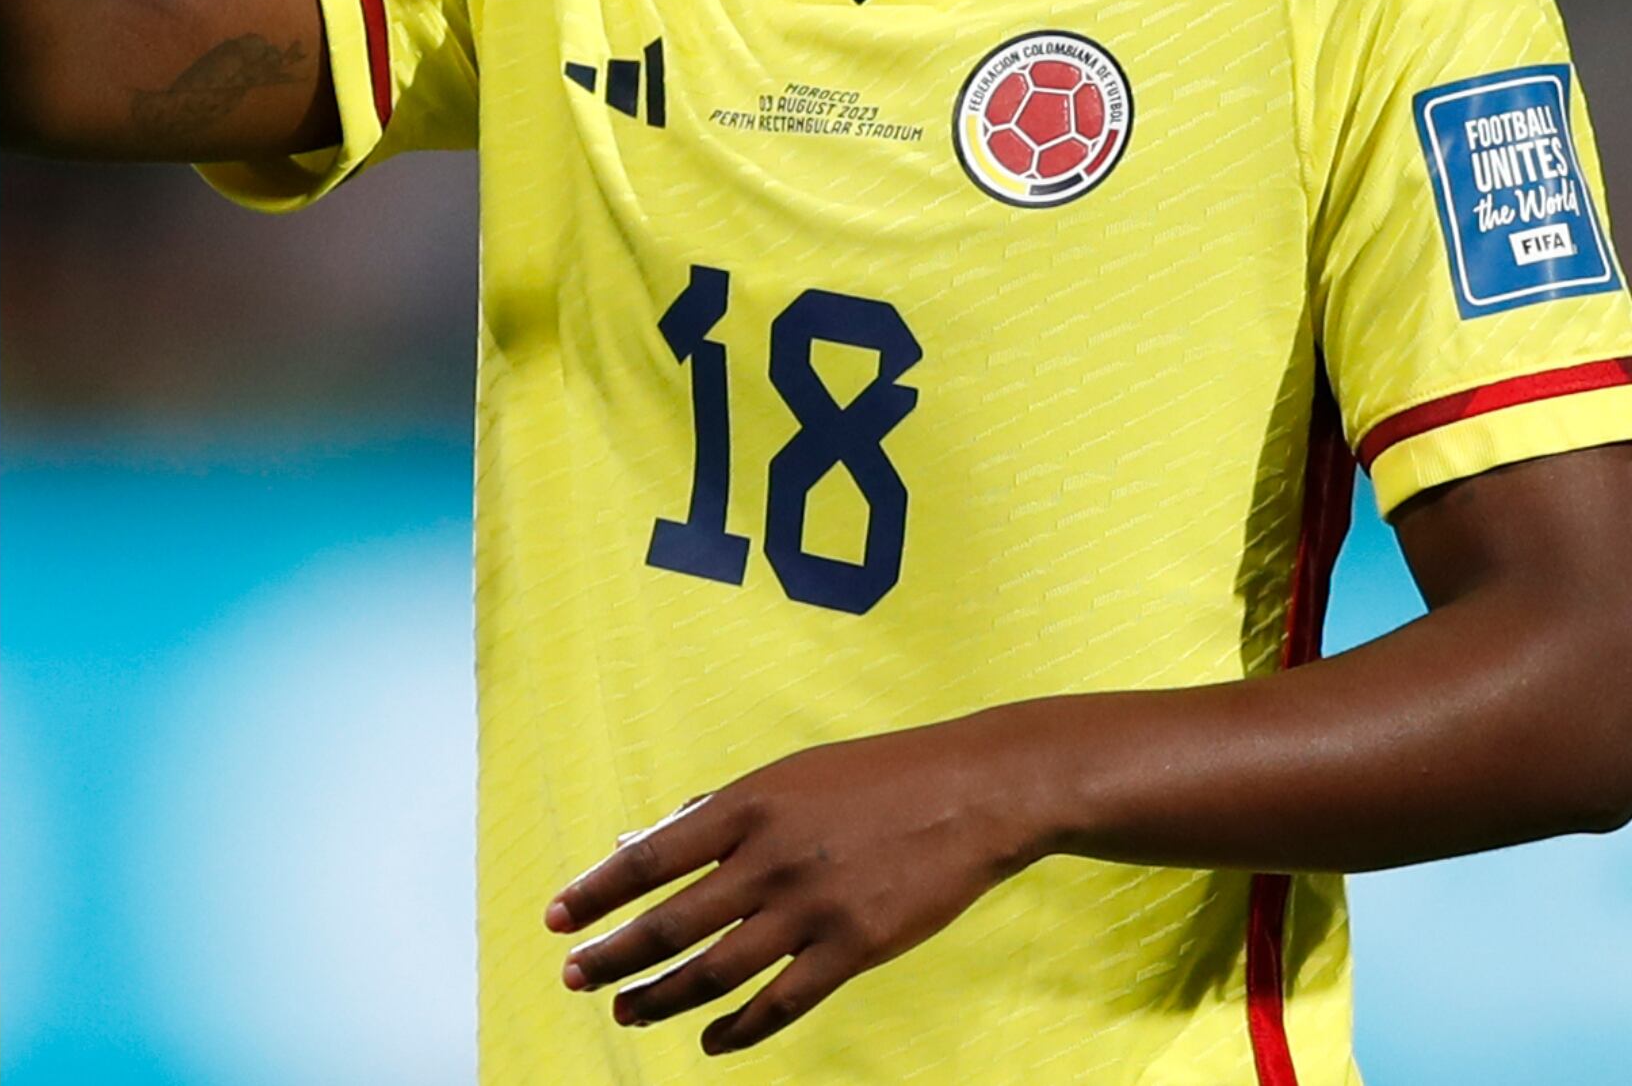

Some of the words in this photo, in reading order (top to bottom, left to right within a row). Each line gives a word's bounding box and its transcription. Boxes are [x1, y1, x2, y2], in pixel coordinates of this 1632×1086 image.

[784, 82, 860, 104] MOROCCO
[1022, 41, 1099, 70] COLOMBIANA
[1096, 65, 1111, 82] DE
[1104, 80, 1123, 124] FUTBOL
[709, 109, 755, 131] PERTH
[758, 114, 852, 135] RECTANGULAR
[855, 122, 923, 142] STADIUM
[759, 95, 773, 112] 03
[776, 97, 834, 116] AUGUST
[838, 106, 879, 121] 2023
[1465, 105, 1558, 151] FOOTBALL
[1471, 137, 1568, 194] UNITES
[1473, 194, 1516, 233] the
[1514, 179, 1581, 223] World
[1521, 234, 1566, 256] FIFA
[645, 264, 923, 616] 18
